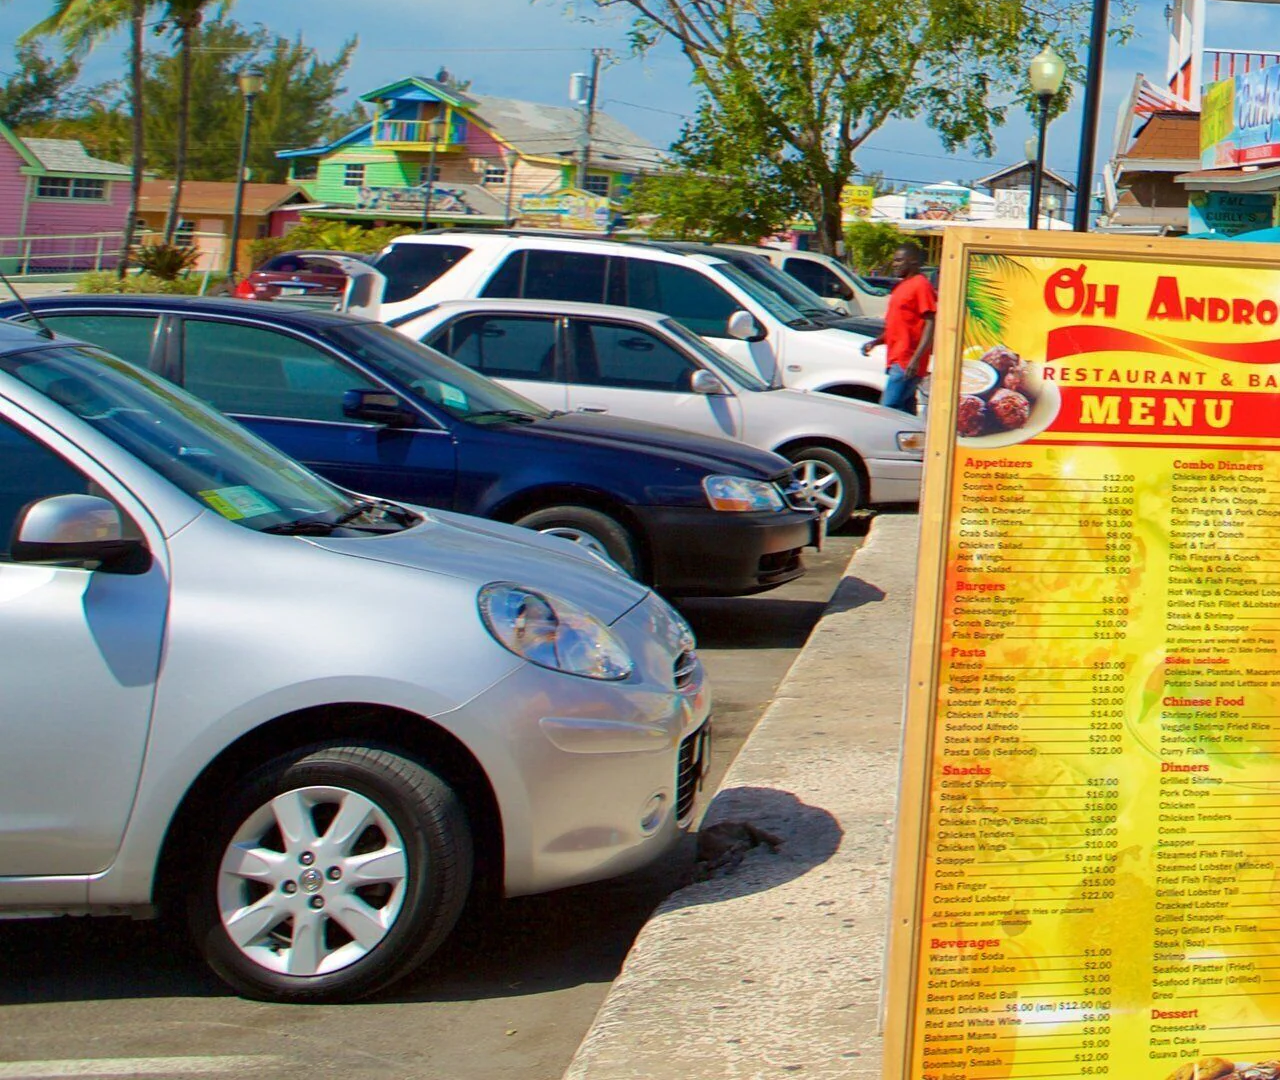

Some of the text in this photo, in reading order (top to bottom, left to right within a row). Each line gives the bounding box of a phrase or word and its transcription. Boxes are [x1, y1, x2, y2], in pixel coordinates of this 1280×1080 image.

[1043, 366, 1208, 387] RESTAURANT
[1220, 372, 1234, 388] &
[1079, 395, 1235, 429] MENU
[964, 458, 1033, 470] Appetizers
[1173, 460, 1264, 471] Combo Dinners
[963, 472, 1135, 482] Conch Salad $12.00
[962, 483, 993, 491] Scorch
[996, 483, 1023, 491] Conch
[962, 495, 997, 504] Tropical
[999, 495, 1024, 503] Salad
[992, 507, 1031, 515] Chowder
[958, 542, 1023, 550] Chicken Salad
[955, 581, 1006, 593] Burgers
[1226, 578, 1258, 587] Fingers
[994, 596, 1024, 605] Burger
[953, 608, 1016, 618] Cheeseburger
[951, 632, 1126, 641] Fish Burger $11.00
[950, 647, 986, 657] Pasta
[947, 698, 1124, 707] Lobster Alfredo $20.00
[1163, 696, 1245, 707] Chinese Food
[942, 765, 991, 775] Snacks
[1161, 763, 1209, 773] Dinners
[1160, 777, 1223, 786] Grilled Shrimp
[933, 892, 1114, 904] Cracked Lobster $22.00
[931, 938, 1000, 949] Beverages
[928, 980, 947, 989] Soft
[950, 980, 981, 988] Drinks
[1151, 1009, 1199, 1019] Dessert
[1150, 1024, 1206, 1033] Cheesecake
[1149, 1037, 1196, 1046] Rum Cake
[1149, 1049, 1199, 1060] Guava Duff
